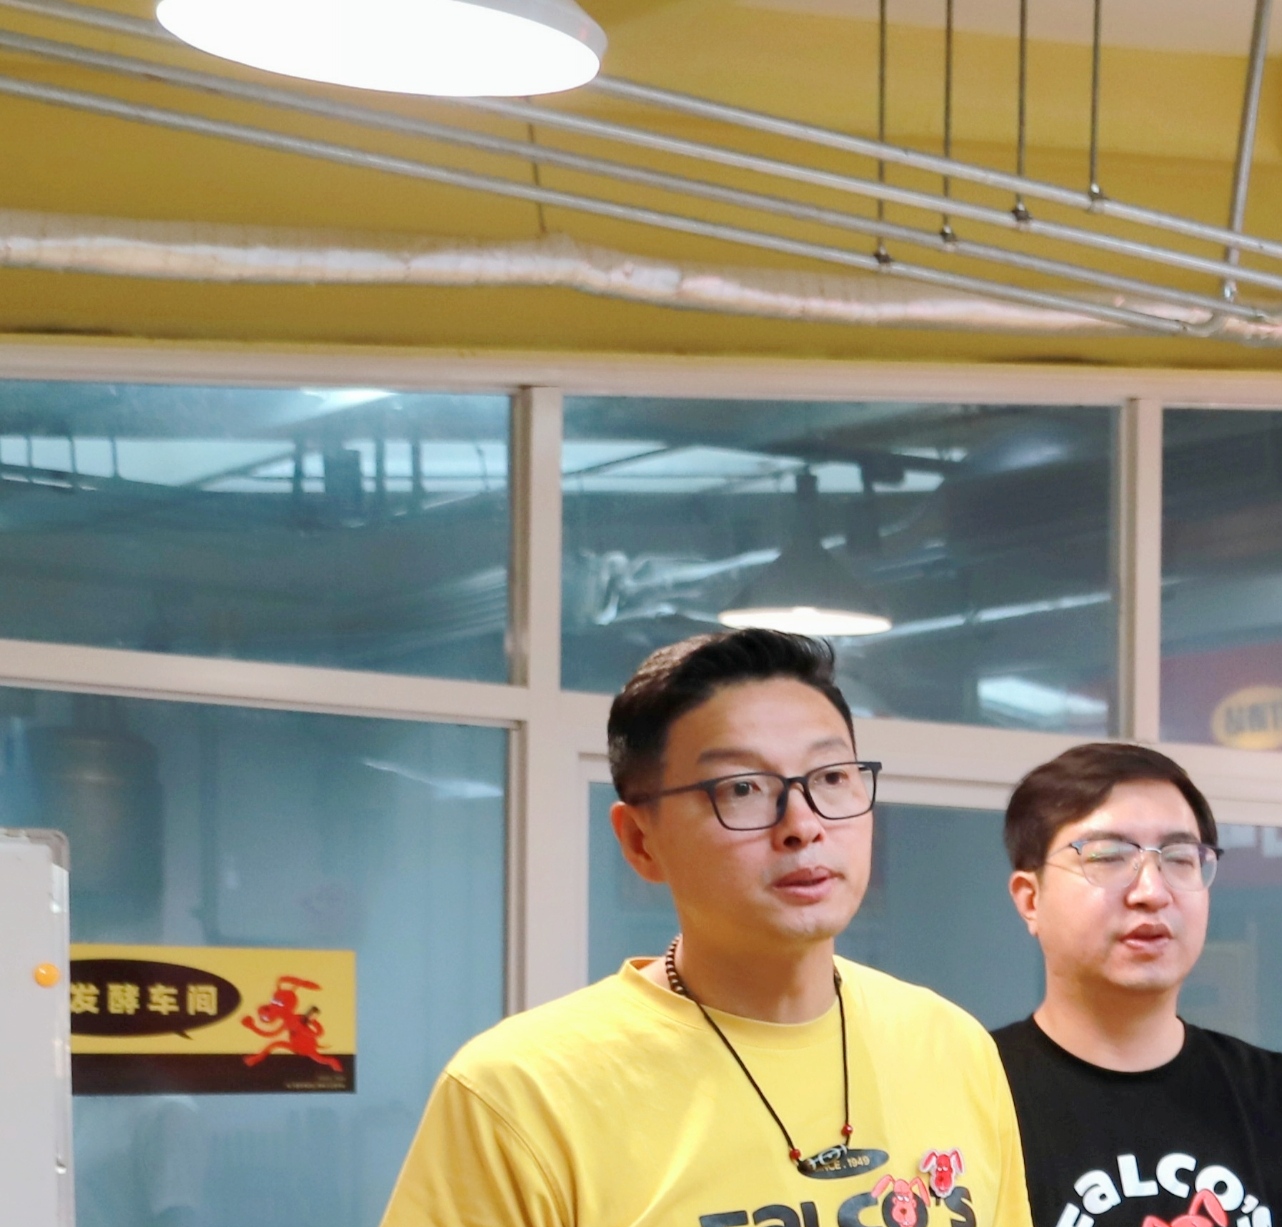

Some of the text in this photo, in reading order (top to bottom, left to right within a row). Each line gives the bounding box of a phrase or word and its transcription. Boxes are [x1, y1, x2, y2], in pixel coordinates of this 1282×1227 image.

[70, 982, 218, 1016] 发酵车间
[846, 1155, 871, 1169] 1949
